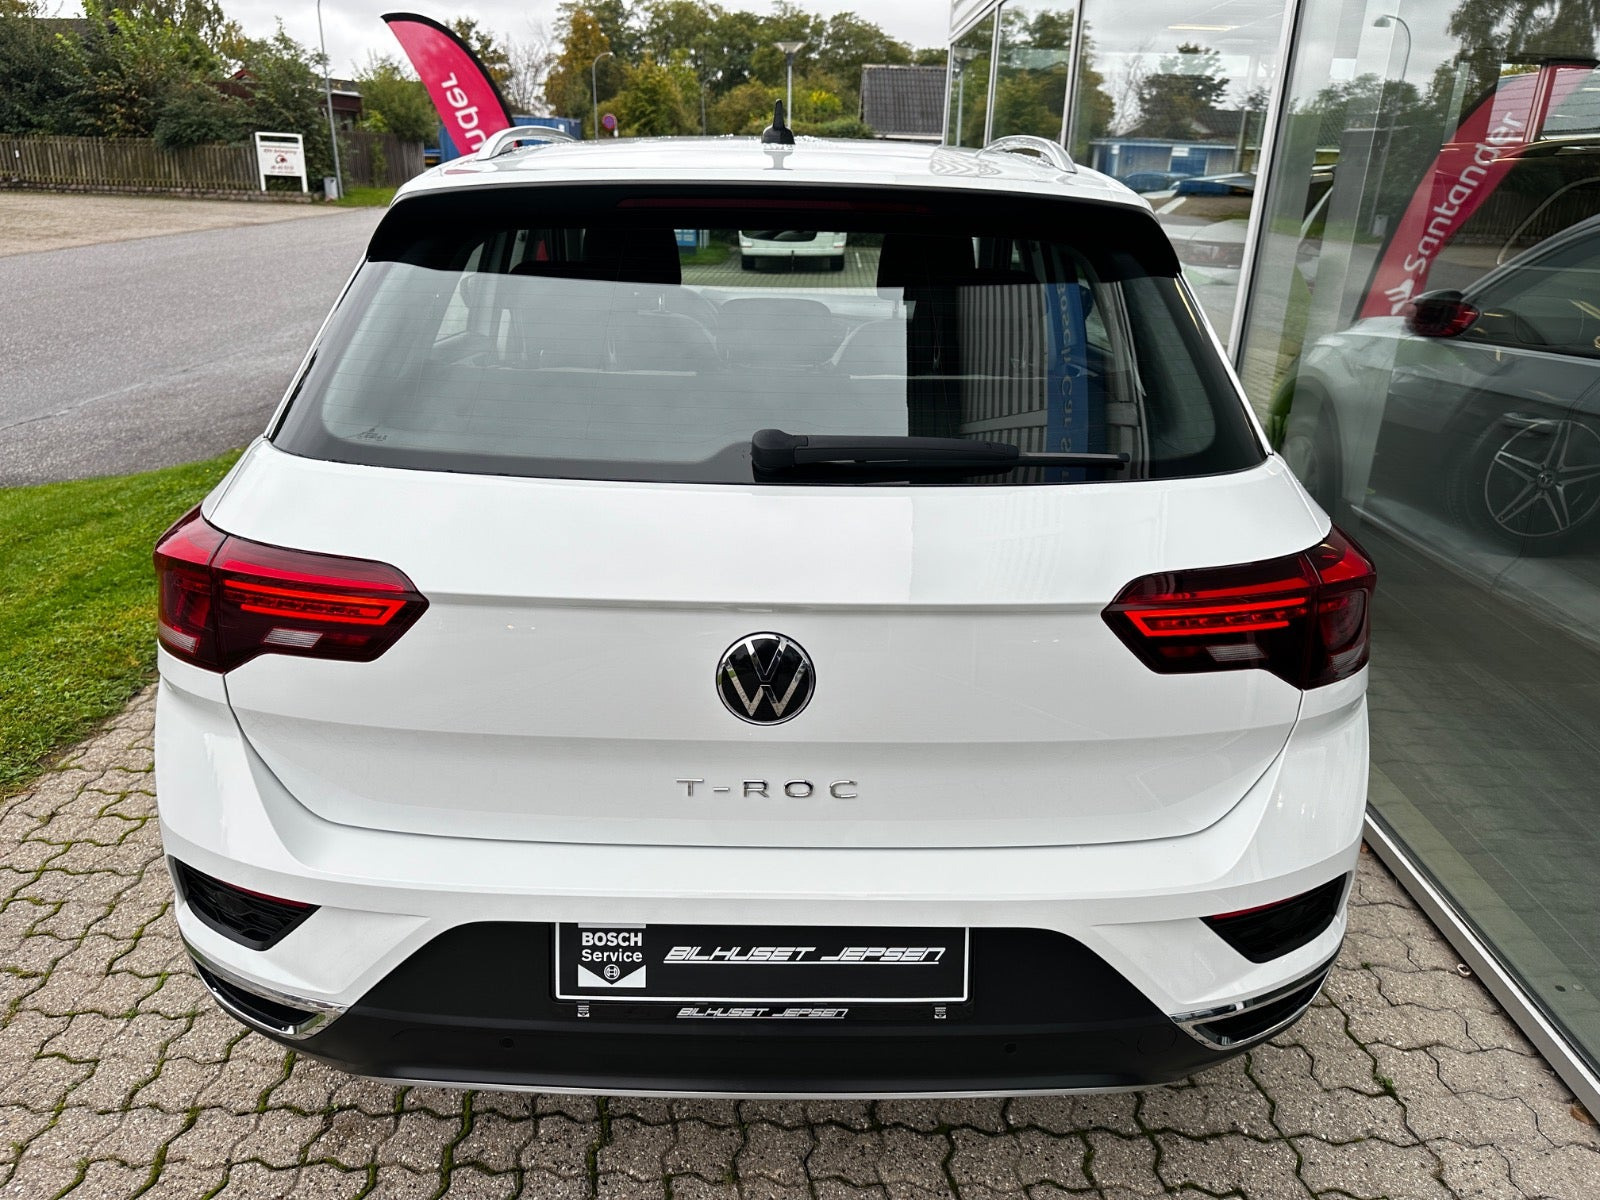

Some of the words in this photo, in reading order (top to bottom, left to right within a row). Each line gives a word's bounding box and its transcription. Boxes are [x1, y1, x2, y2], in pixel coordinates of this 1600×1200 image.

[1403, 112, 1523, 275] Santander
[676, 778, 858, 799] T-ROC
[581, 931, 643, 947] BOSCH
[581, 948, 643, 962] Service
[664, 946, 817, 961] BILHUSET
[819, 947, 947, 961] JEPSEN
[677, 1007, 770, 1017] BILHUSET
[771, 1008, 849, 1017] JEPSEN
